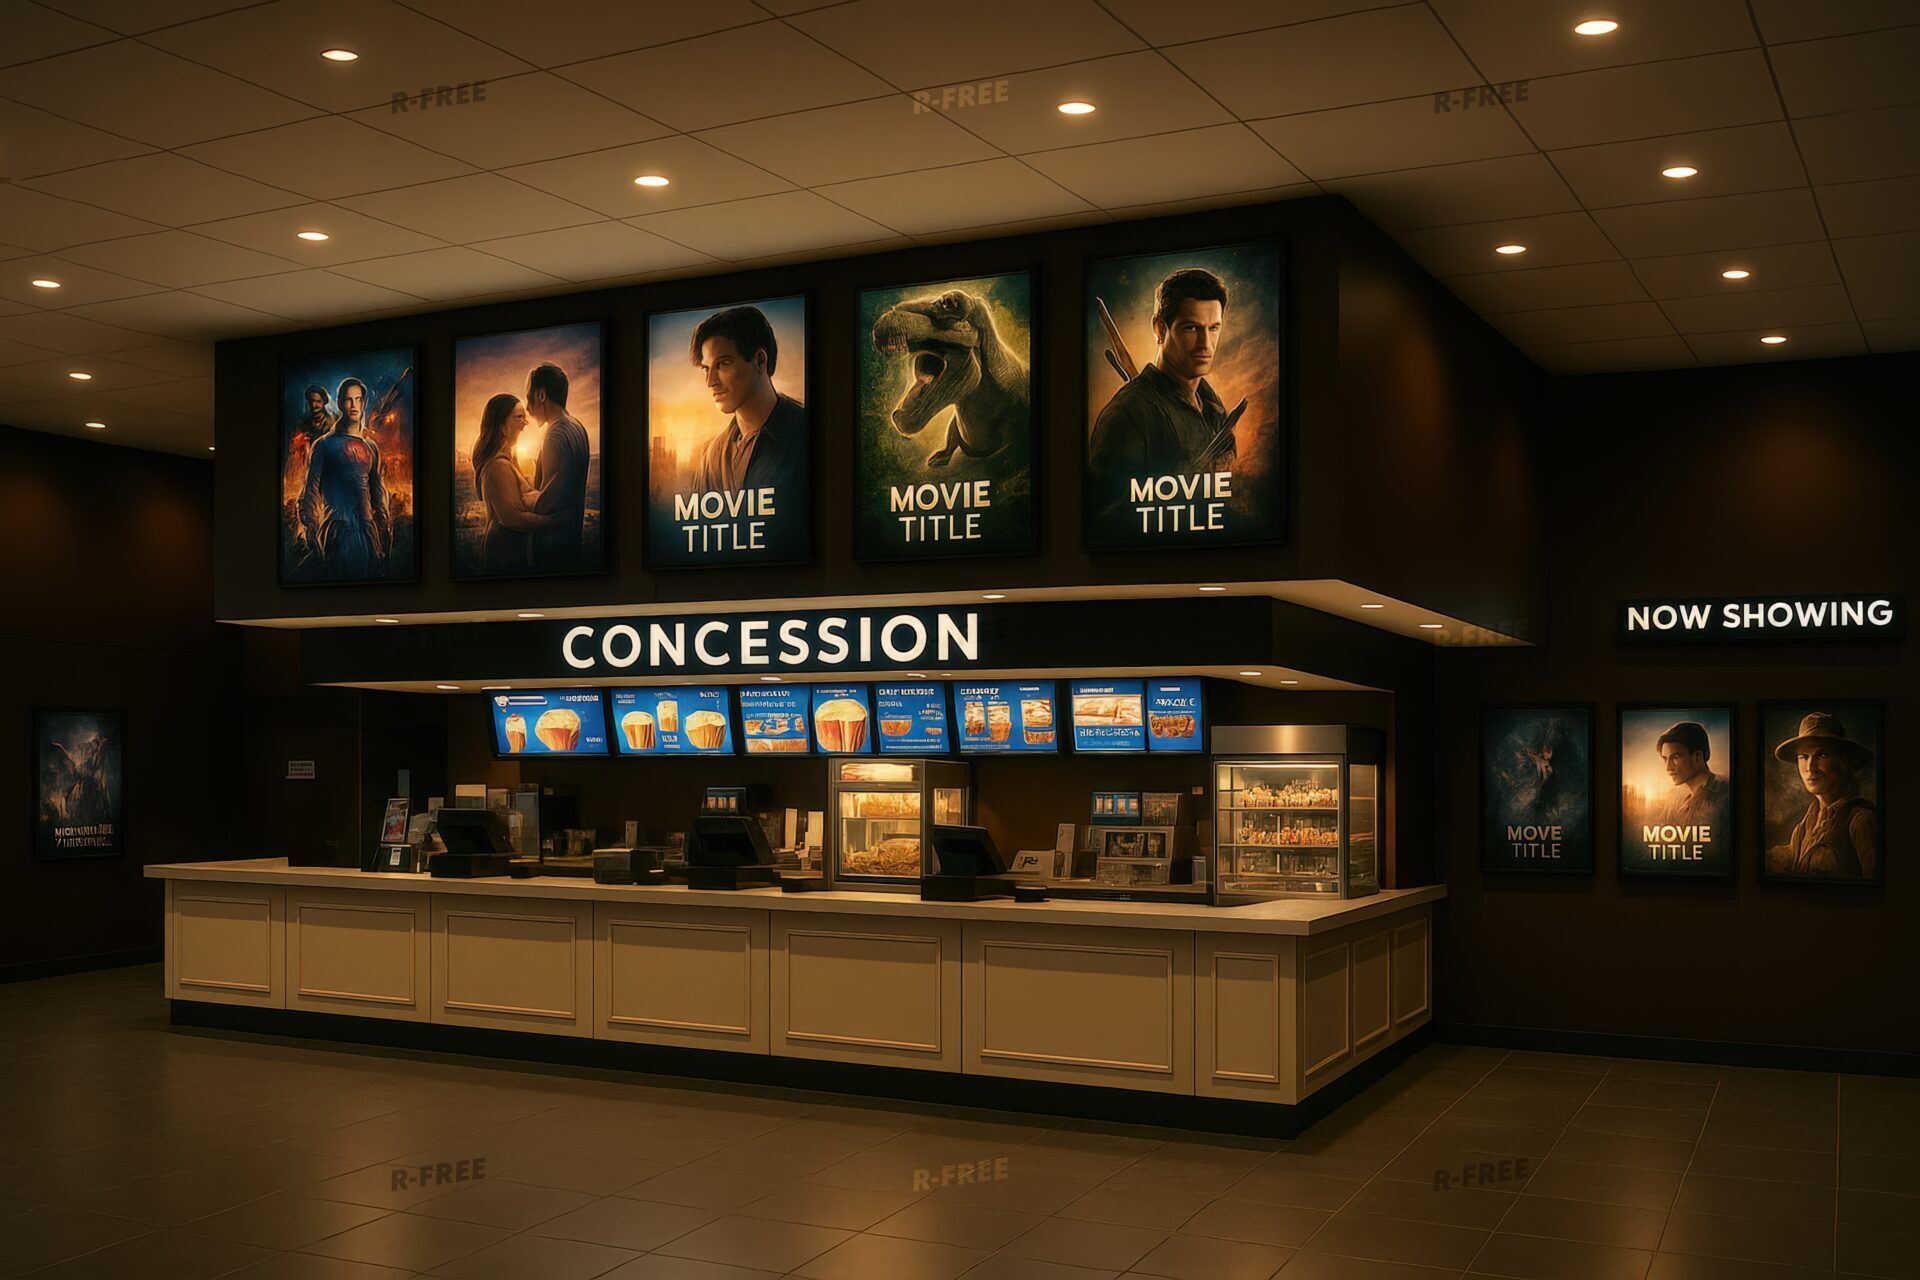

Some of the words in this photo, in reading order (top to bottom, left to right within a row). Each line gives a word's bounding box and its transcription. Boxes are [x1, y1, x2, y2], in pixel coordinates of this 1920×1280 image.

[890, 481, 991, 512] MOVIE
[1130, 472, 1232, 502] MOVIE
[674, 488, 776, 521] MOVIE
[1136, 503, 1225, 533] TITLE
[682, 521, 766, 553] TITLE
[898, 514, 981, 542] TITLE
[1626, 605, 1712, 631] NOW
[1722, 599, 1894, 629] SHOWING
[562, 613, 980, 669] CONCESSION
[1507, 825, 1562, 841] MOVE
[1643, 825, 1712, 843] MOVIE
[1512, 843, 1561, 859] TITLE
[1648, 844, 1703, 861] TITLE
